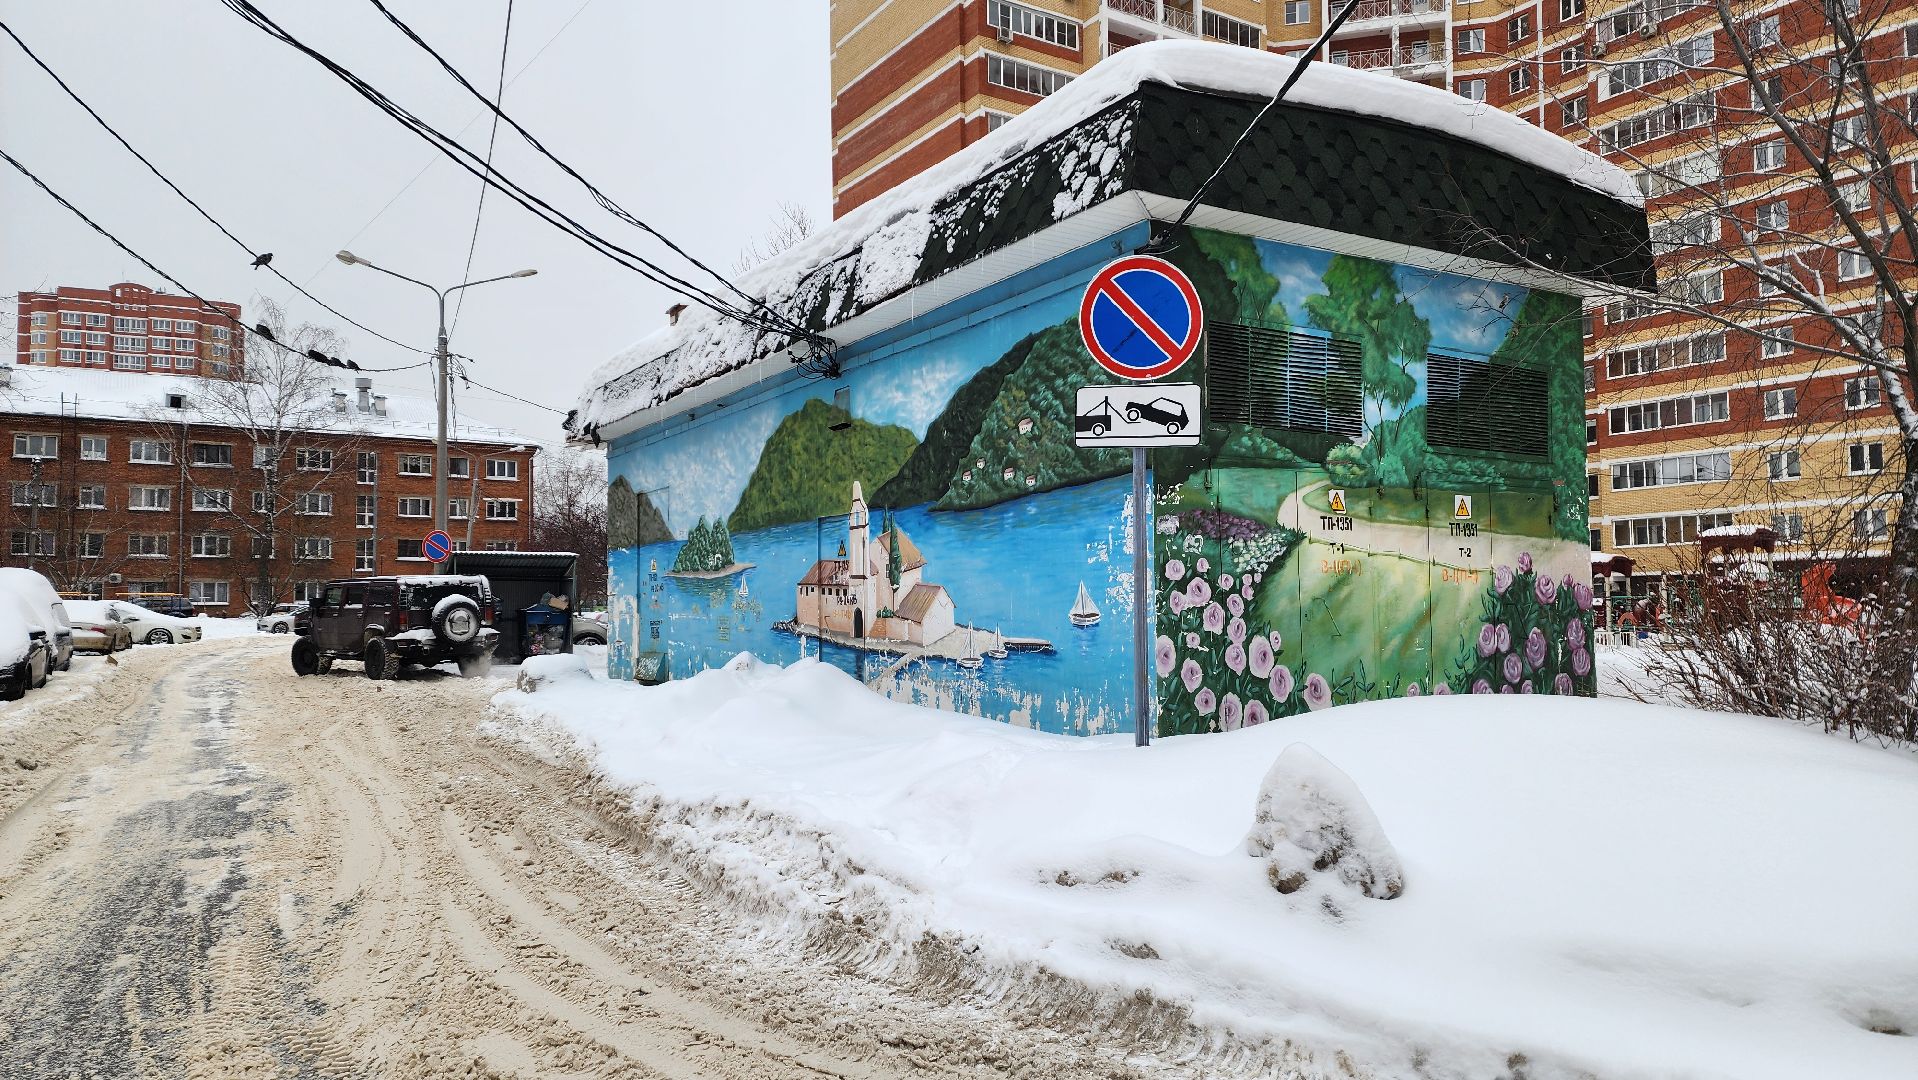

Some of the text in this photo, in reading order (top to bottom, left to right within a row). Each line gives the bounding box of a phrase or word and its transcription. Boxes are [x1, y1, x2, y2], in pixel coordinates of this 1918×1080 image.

[1320, 516, 1353, 531] ТП-1351
[1448, 522, 1478, 537] ТП-1351
[1459, 547, 1472, 558] Т-2
